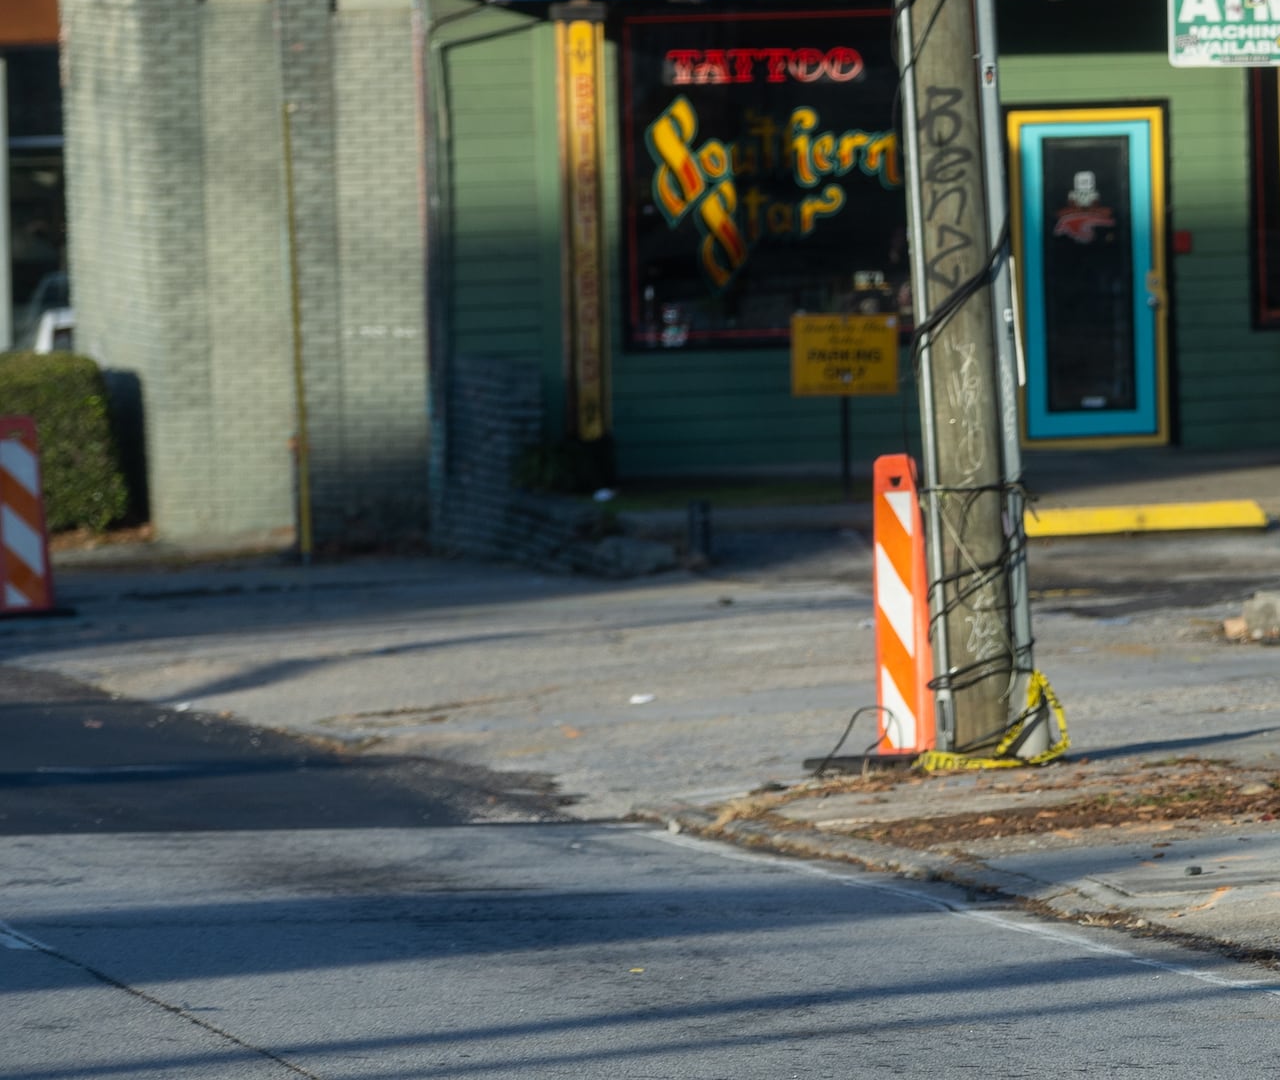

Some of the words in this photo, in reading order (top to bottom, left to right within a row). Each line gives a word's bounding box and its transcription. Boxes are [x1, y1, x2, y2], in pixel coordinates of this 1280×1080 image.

[666, 46, 864, 85] TATTOO
[648, 98, 903, 222] Southern
[700, 182, 847, 287] Star
